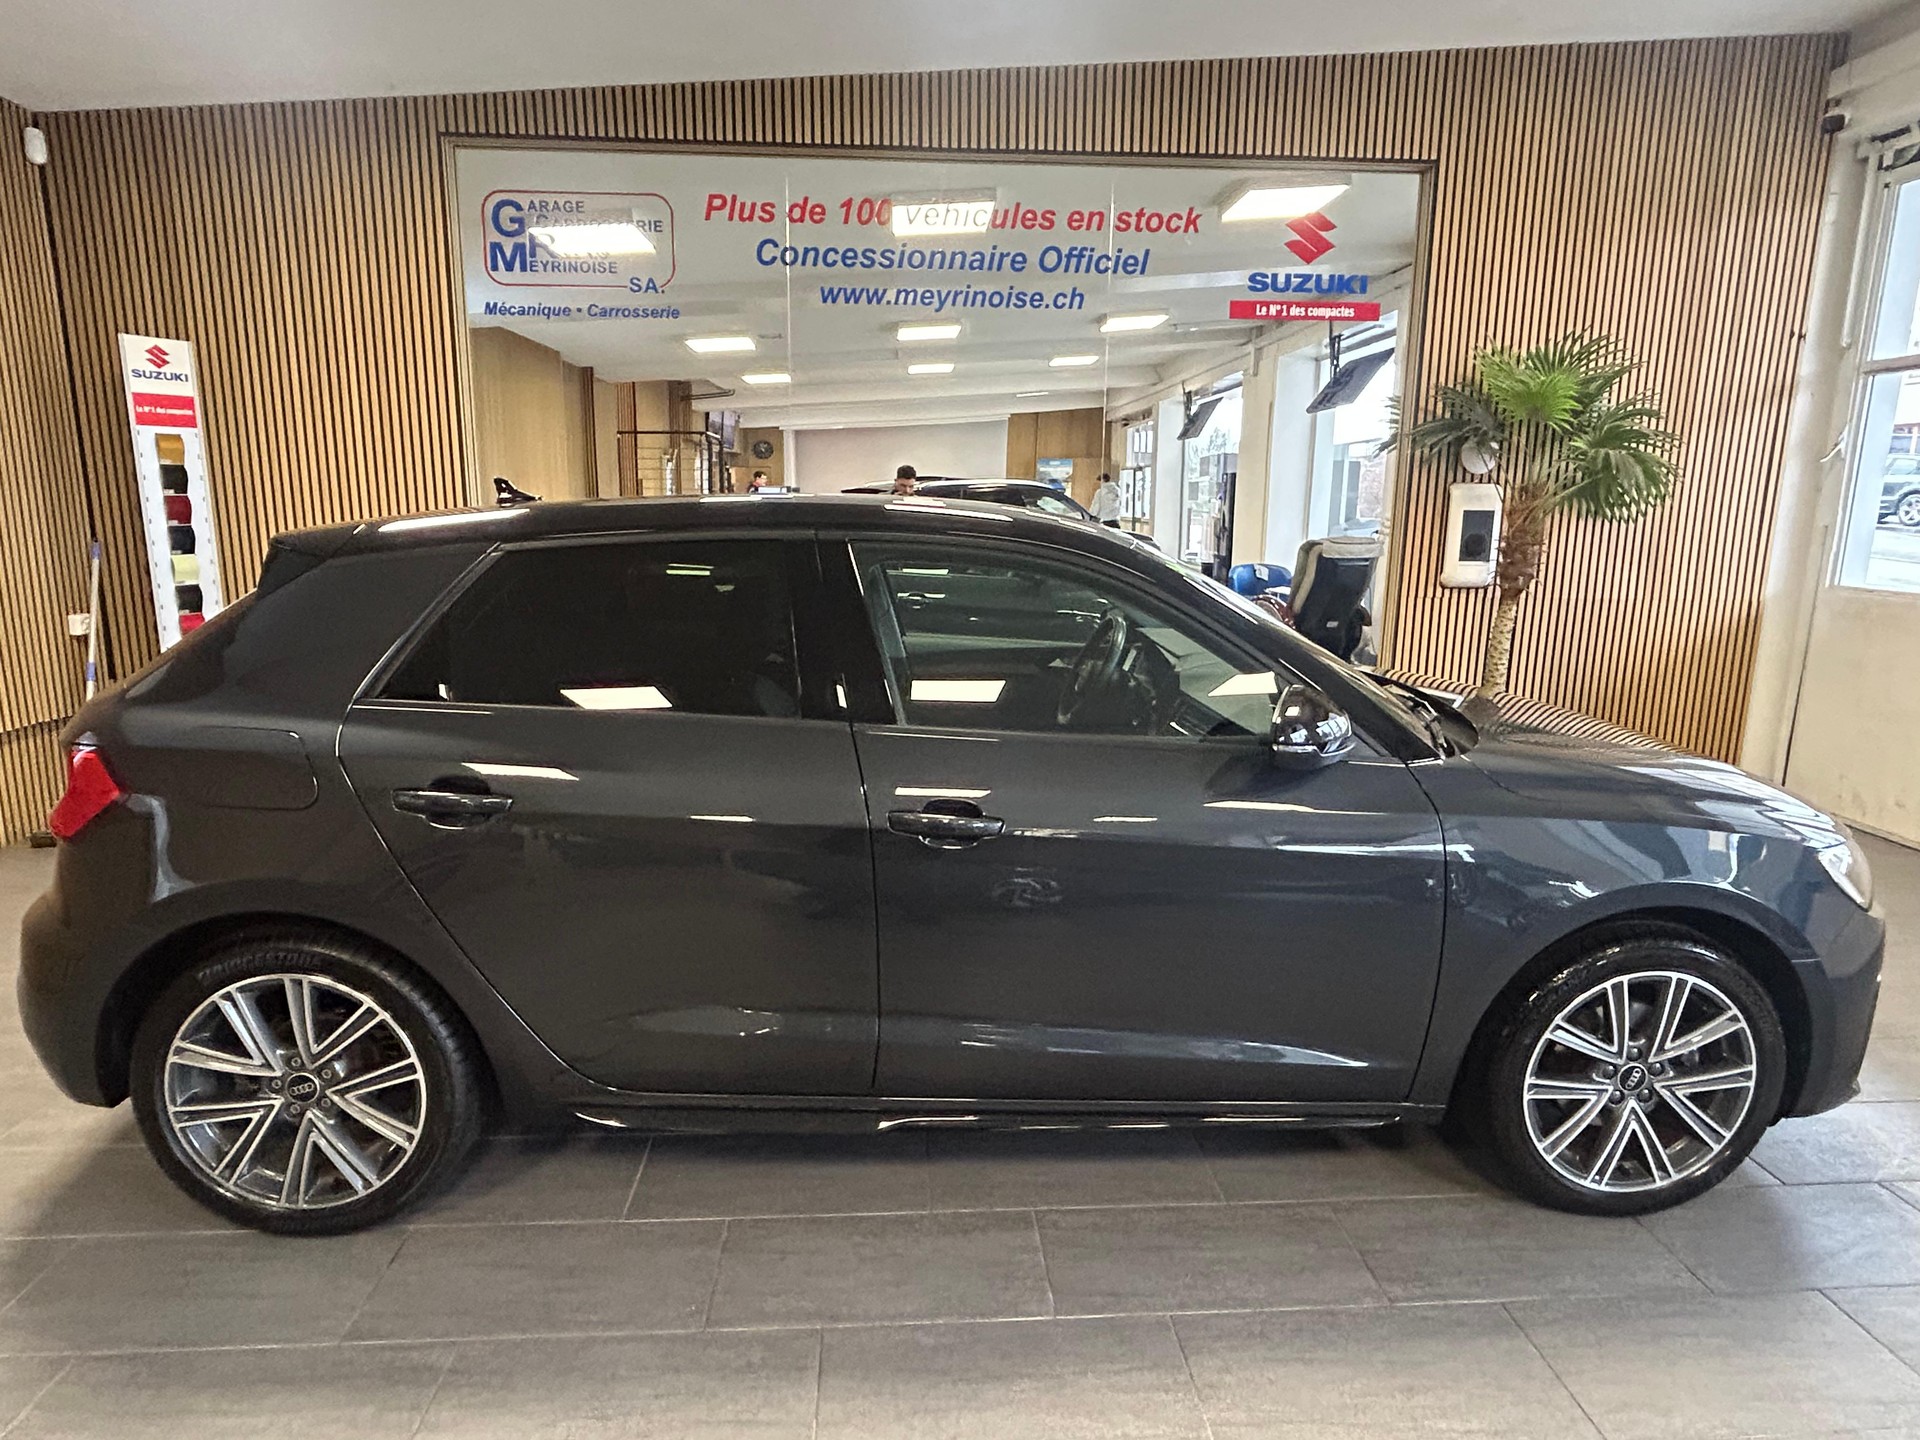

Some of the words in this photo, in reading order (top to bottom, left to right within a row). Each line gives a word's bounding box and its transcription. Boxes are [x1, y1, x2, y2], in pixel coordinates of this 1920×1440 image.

[704, 193, 776, 223] Plus
[787, 196, 827, 224] de
[1067, 209, 1105, 232] en
[1114, 206, 1202, 234] stock
[756, 238, 1027, 274] Concessionnaire
[1038, 245, 1150, 275] Officiel
[1247, 271, 1368, 294] SUZUKI
[484, 301, 572, 320] Mécanique
[587, 303, 681, 320] Carrosserie
[820, 285, 1085, 313] www.meyrinoise.ch
[1256, 303, 1267, 316] Le
[1289, 304, 1305, 317] des
[1307, 306, 1355, 319] compactes
[131, 368, 189, 383] SUZUKI
